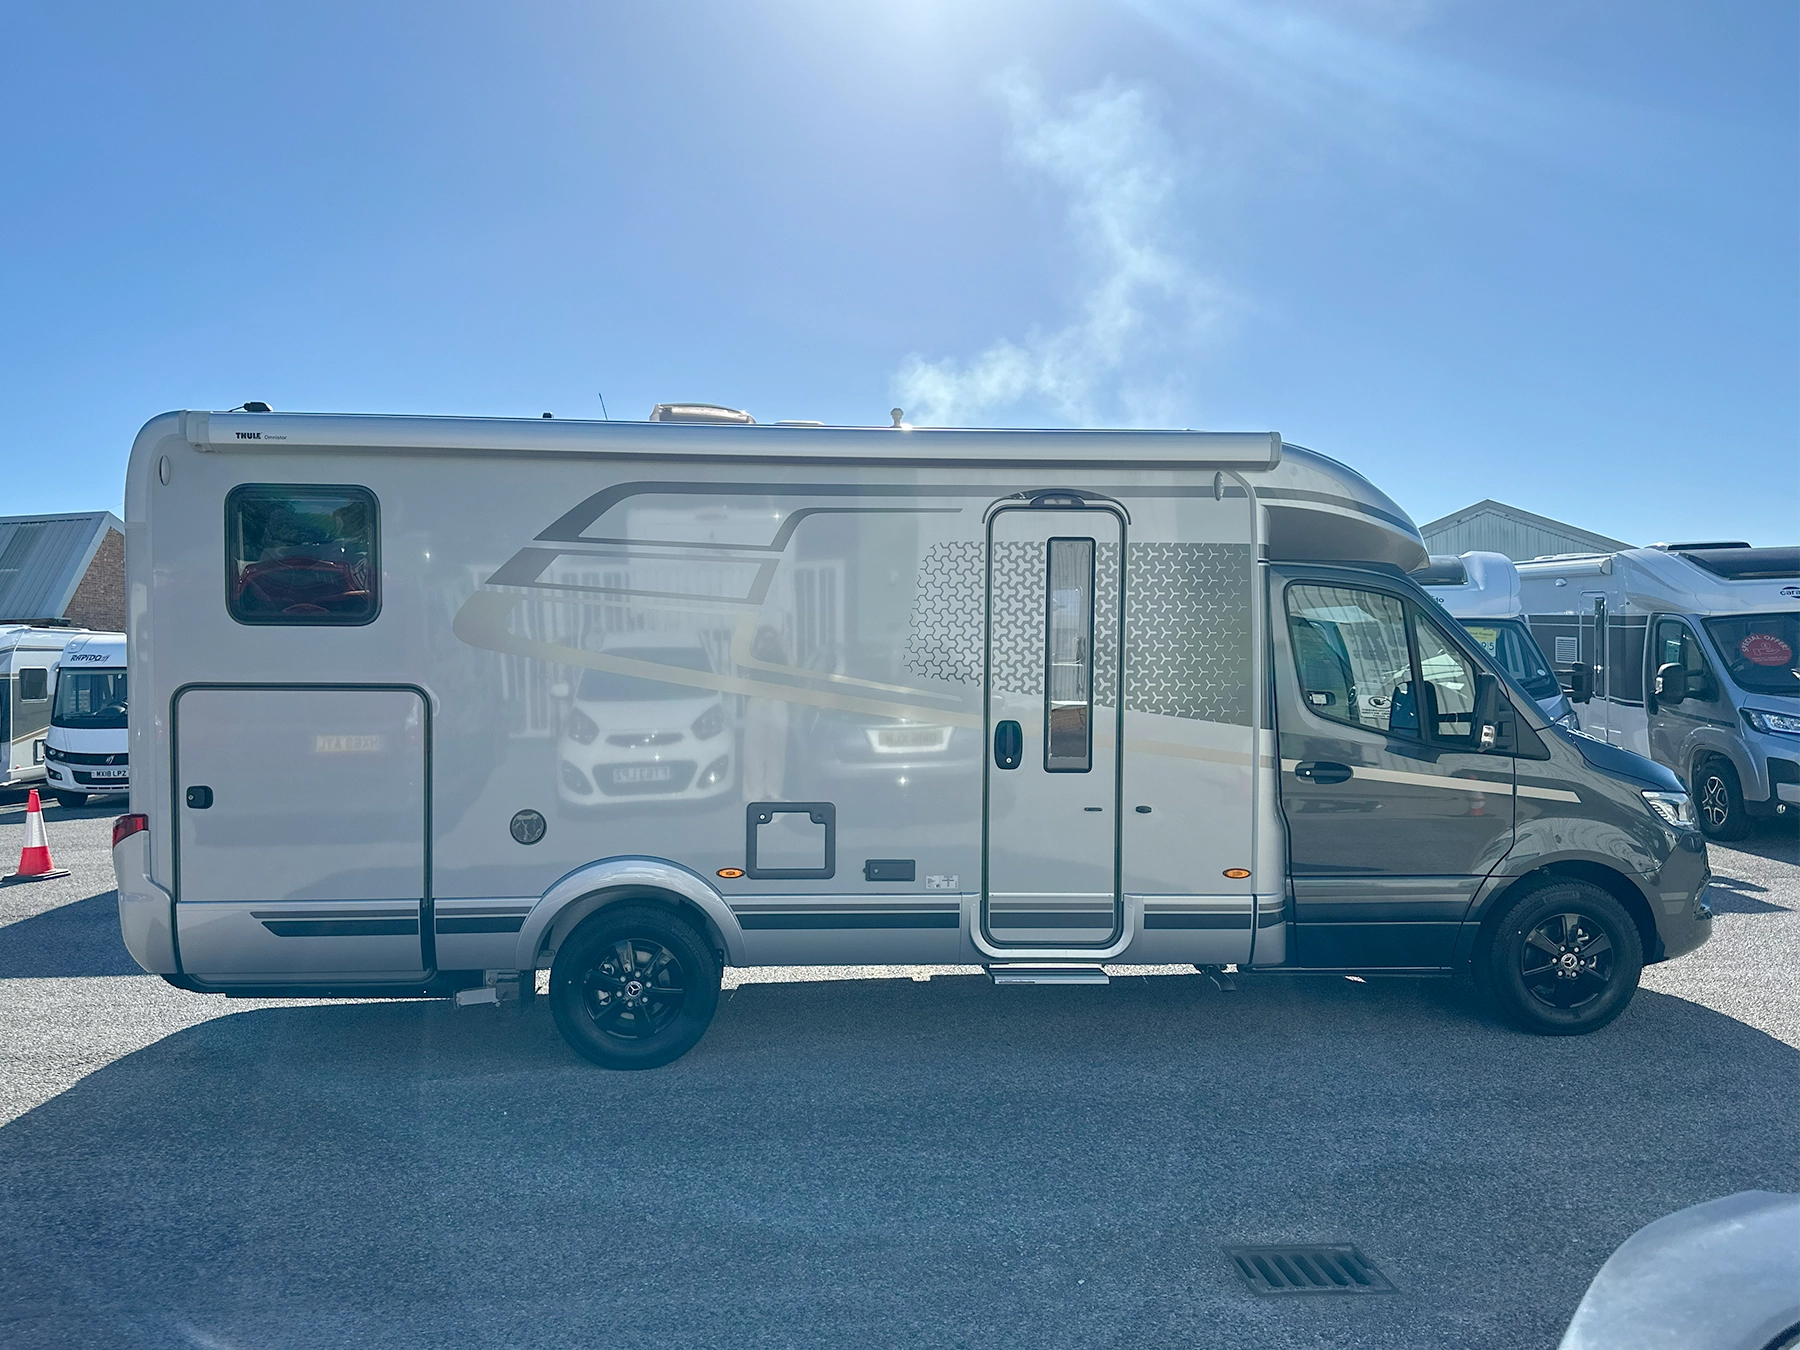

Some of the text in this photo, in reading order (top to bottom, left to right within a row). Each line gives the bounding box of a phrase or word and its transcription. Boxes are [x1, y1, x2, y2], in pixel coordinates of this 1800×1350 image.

[235, 432, 261, 440] THULE
[1741, 634, 1790, 652] SPECIAL OFFER!
[70, 654, 102, 662] RAPIDO
